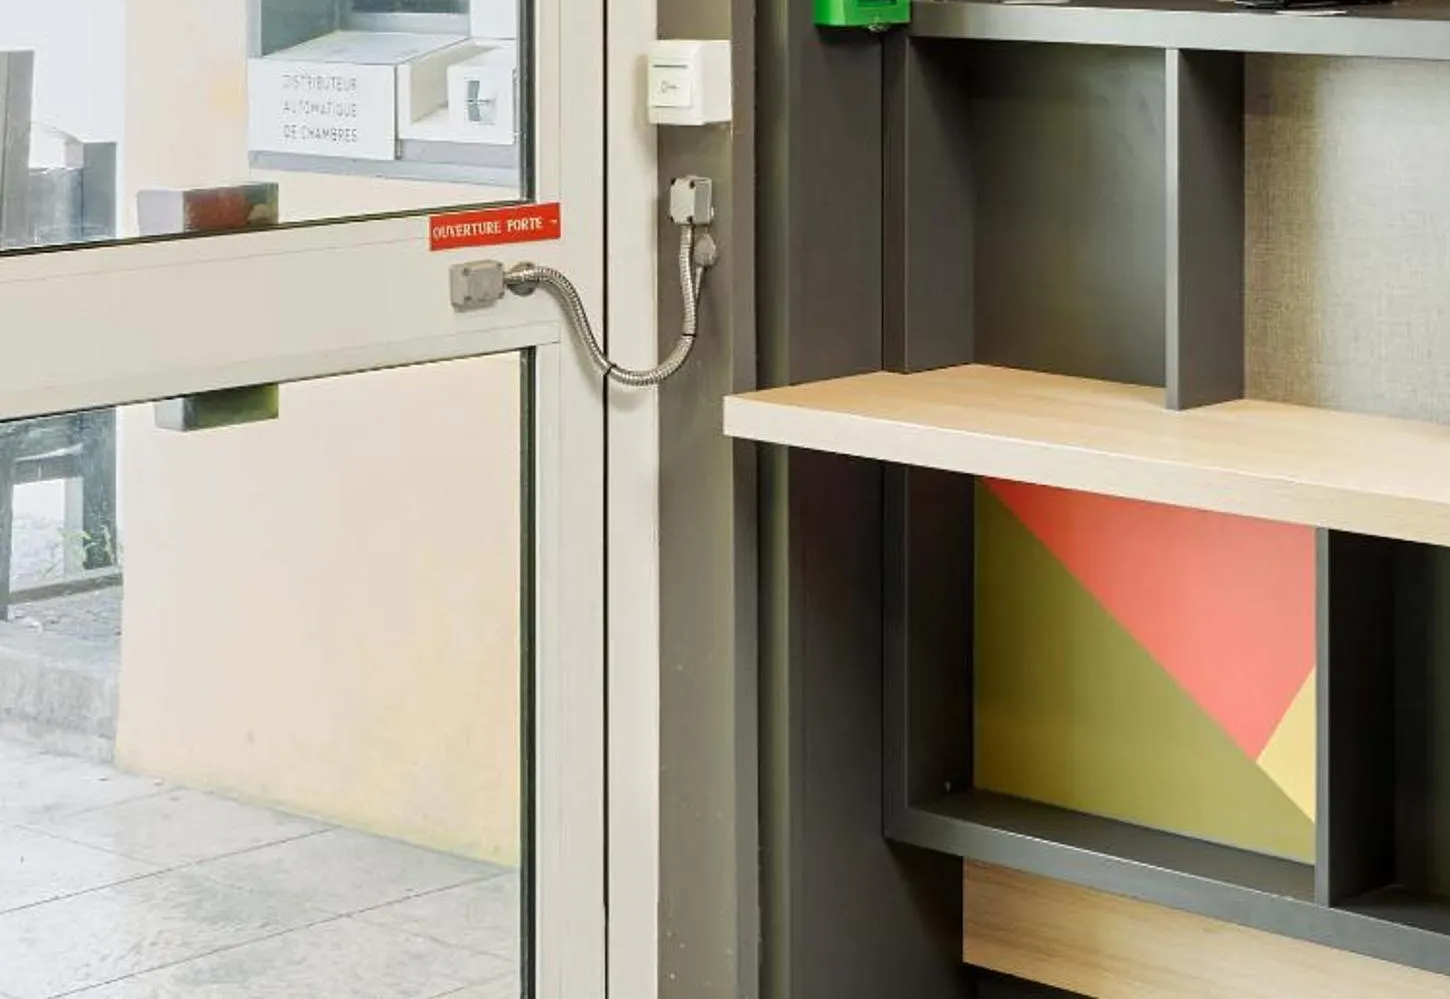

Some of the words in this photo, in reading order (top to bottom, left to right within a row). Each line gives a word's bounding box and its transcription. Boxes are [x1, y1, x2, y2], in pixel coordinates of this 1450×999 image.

[282, 73, 357, 92] DISTRIBUTEUR
[283, 99, 357, 118] AUTOMATIQUE
[283, 123, 297, 140] DE
[301, 123, 358, 144] CHAMBRES
[432, 220, 502, 241] OUVERTURE
